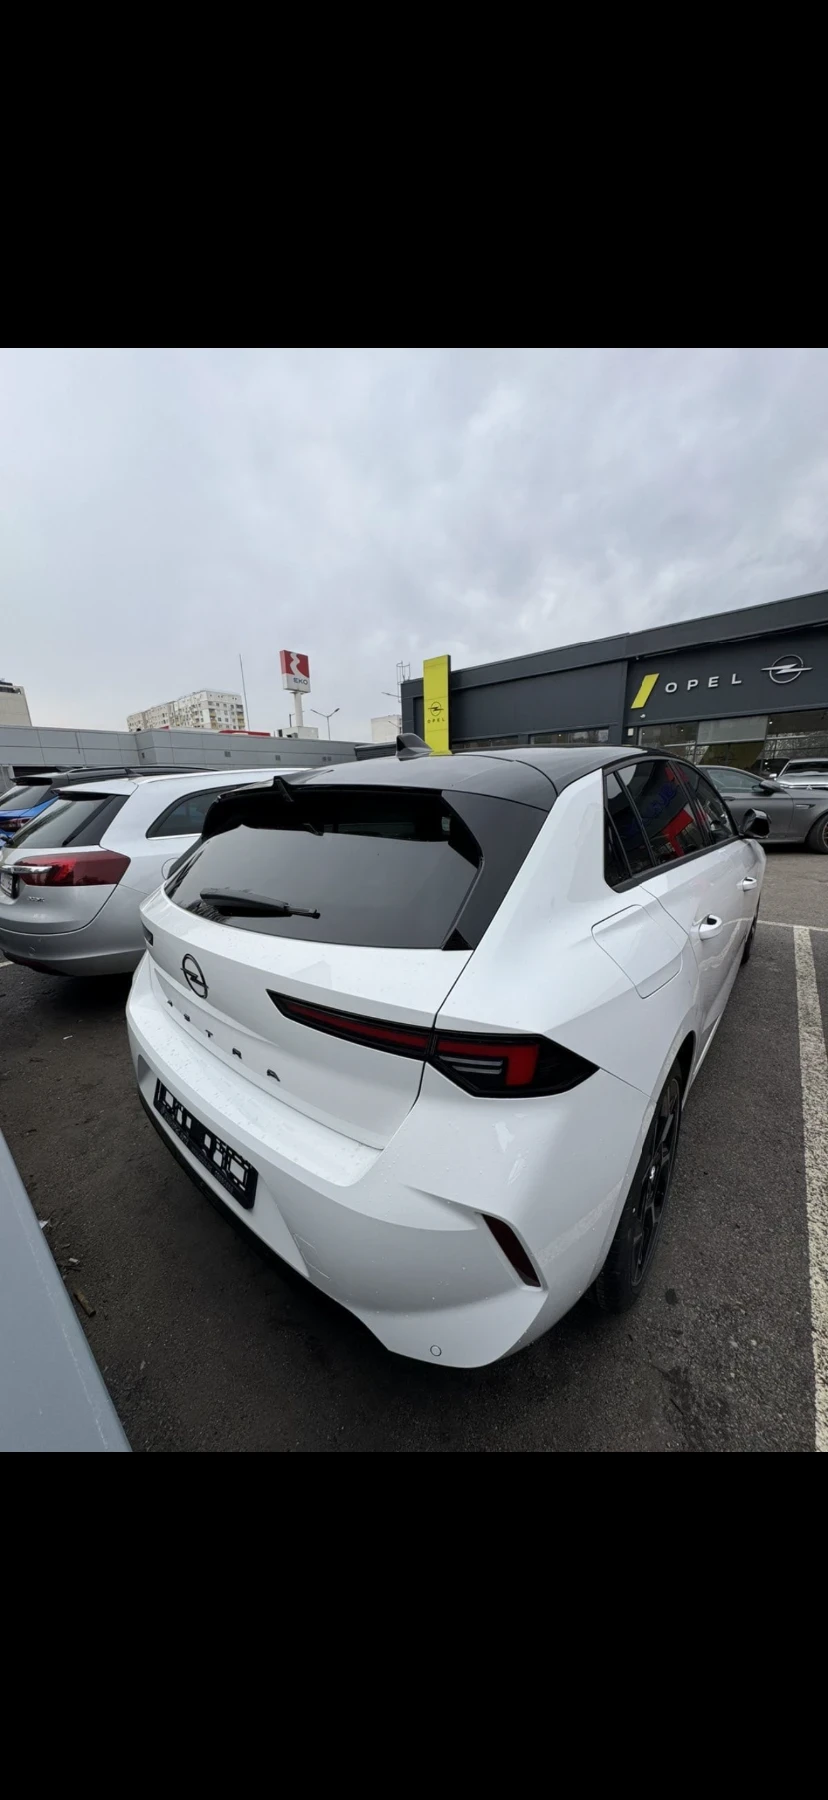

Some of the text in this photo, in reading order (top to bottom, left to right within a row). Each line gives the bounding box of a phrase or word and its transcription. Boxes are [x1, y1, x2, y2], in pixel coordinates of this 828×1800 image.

[293, 677, 309, 686] EKO
[665, 673, 742, 693] OPEL
[167, 1000, 281, 1082] ASTRA
